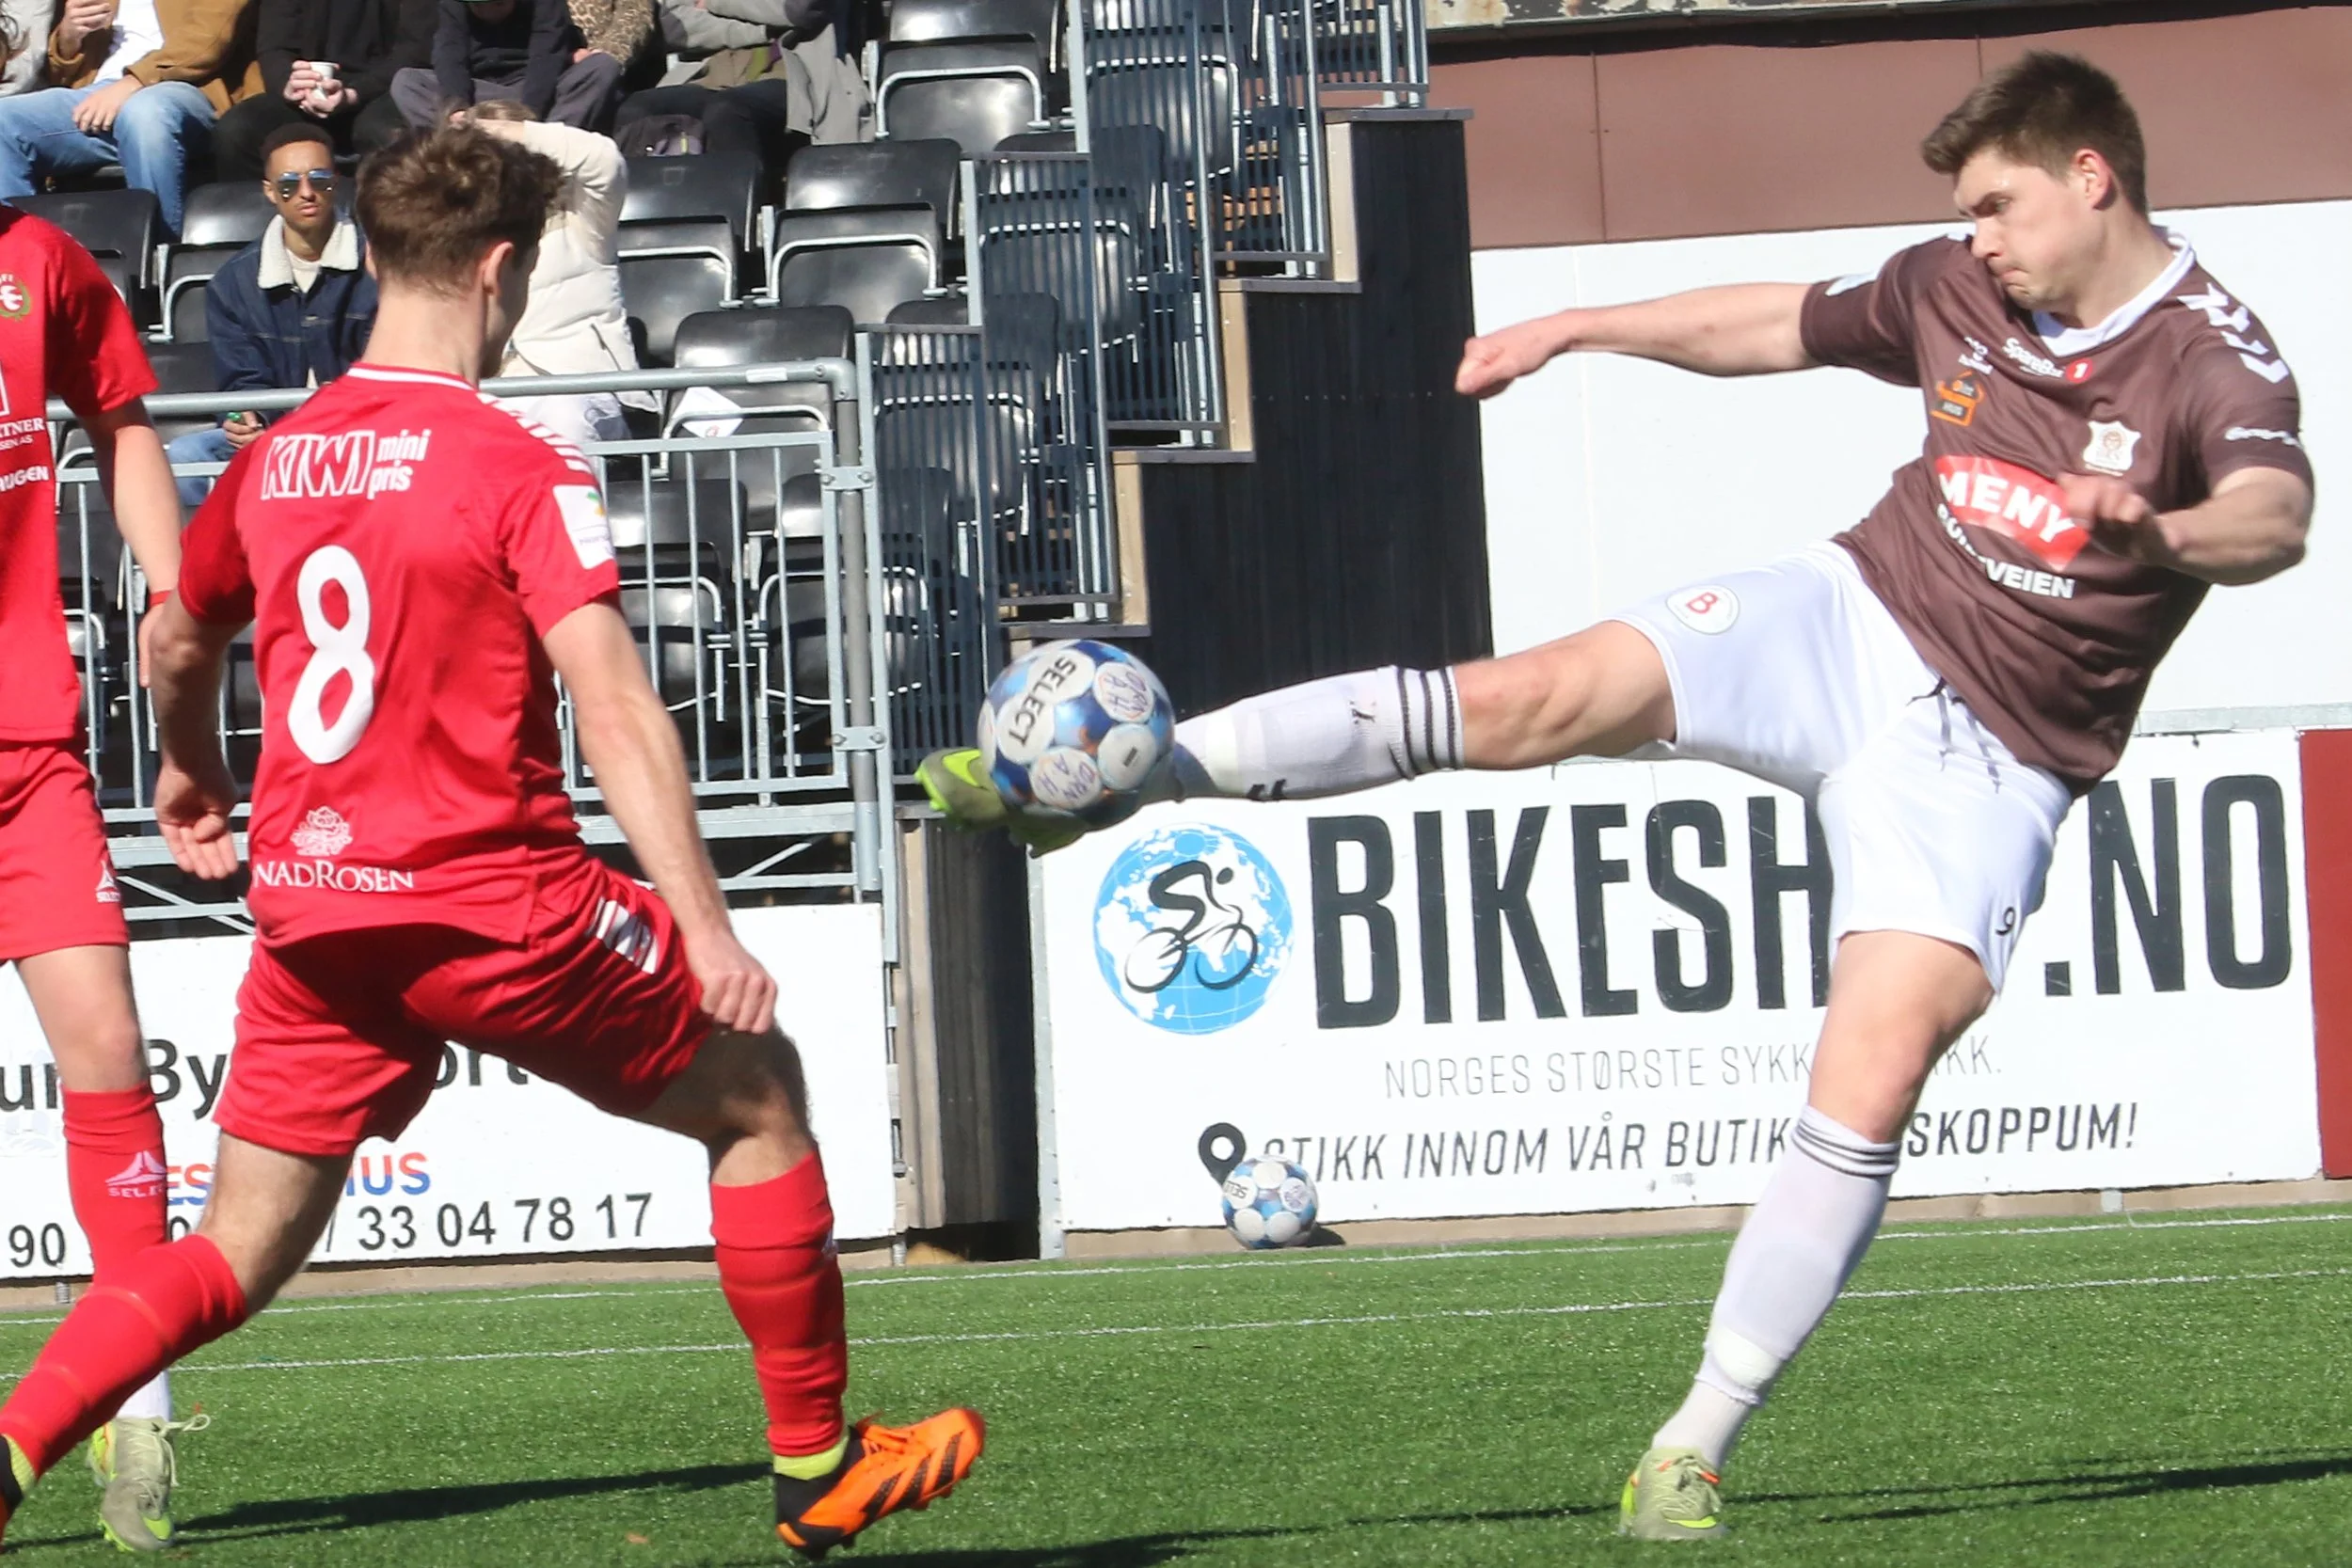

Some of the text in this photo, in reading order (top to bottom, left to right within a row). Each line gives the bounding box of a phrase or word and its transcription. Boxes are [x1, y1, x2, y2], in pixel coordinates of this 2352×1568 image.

[261, 430, 375, 500] KIWI
[367, 459, 414, 500] pris
[376, 429, 432, 463] mini
[1938, 470, 2076, 544] MENY
[287, 545, 376, 765] 8
[1008, 656, 1078, 747] SELECT
[1994, 906, 2017, 937] 9
[1385, 1054, 1531, 1099] NORGES
[1547, 1047, 1705, 1093] STØRSTE
[1404, 1128, 1549, 1179] INNOM
[1568, 1111, 1646, 1171] VÅR
[1906, 1101, 2137, 1158] SKOPPUM!
[8, 1222, 67, 1269] 90
[357, 1205, 417, 1251] 33
[437, 1201, 497, 1248] 04
[515, 1196, 574, 1243] 78
[596, 1192, 653, 1239] 17
